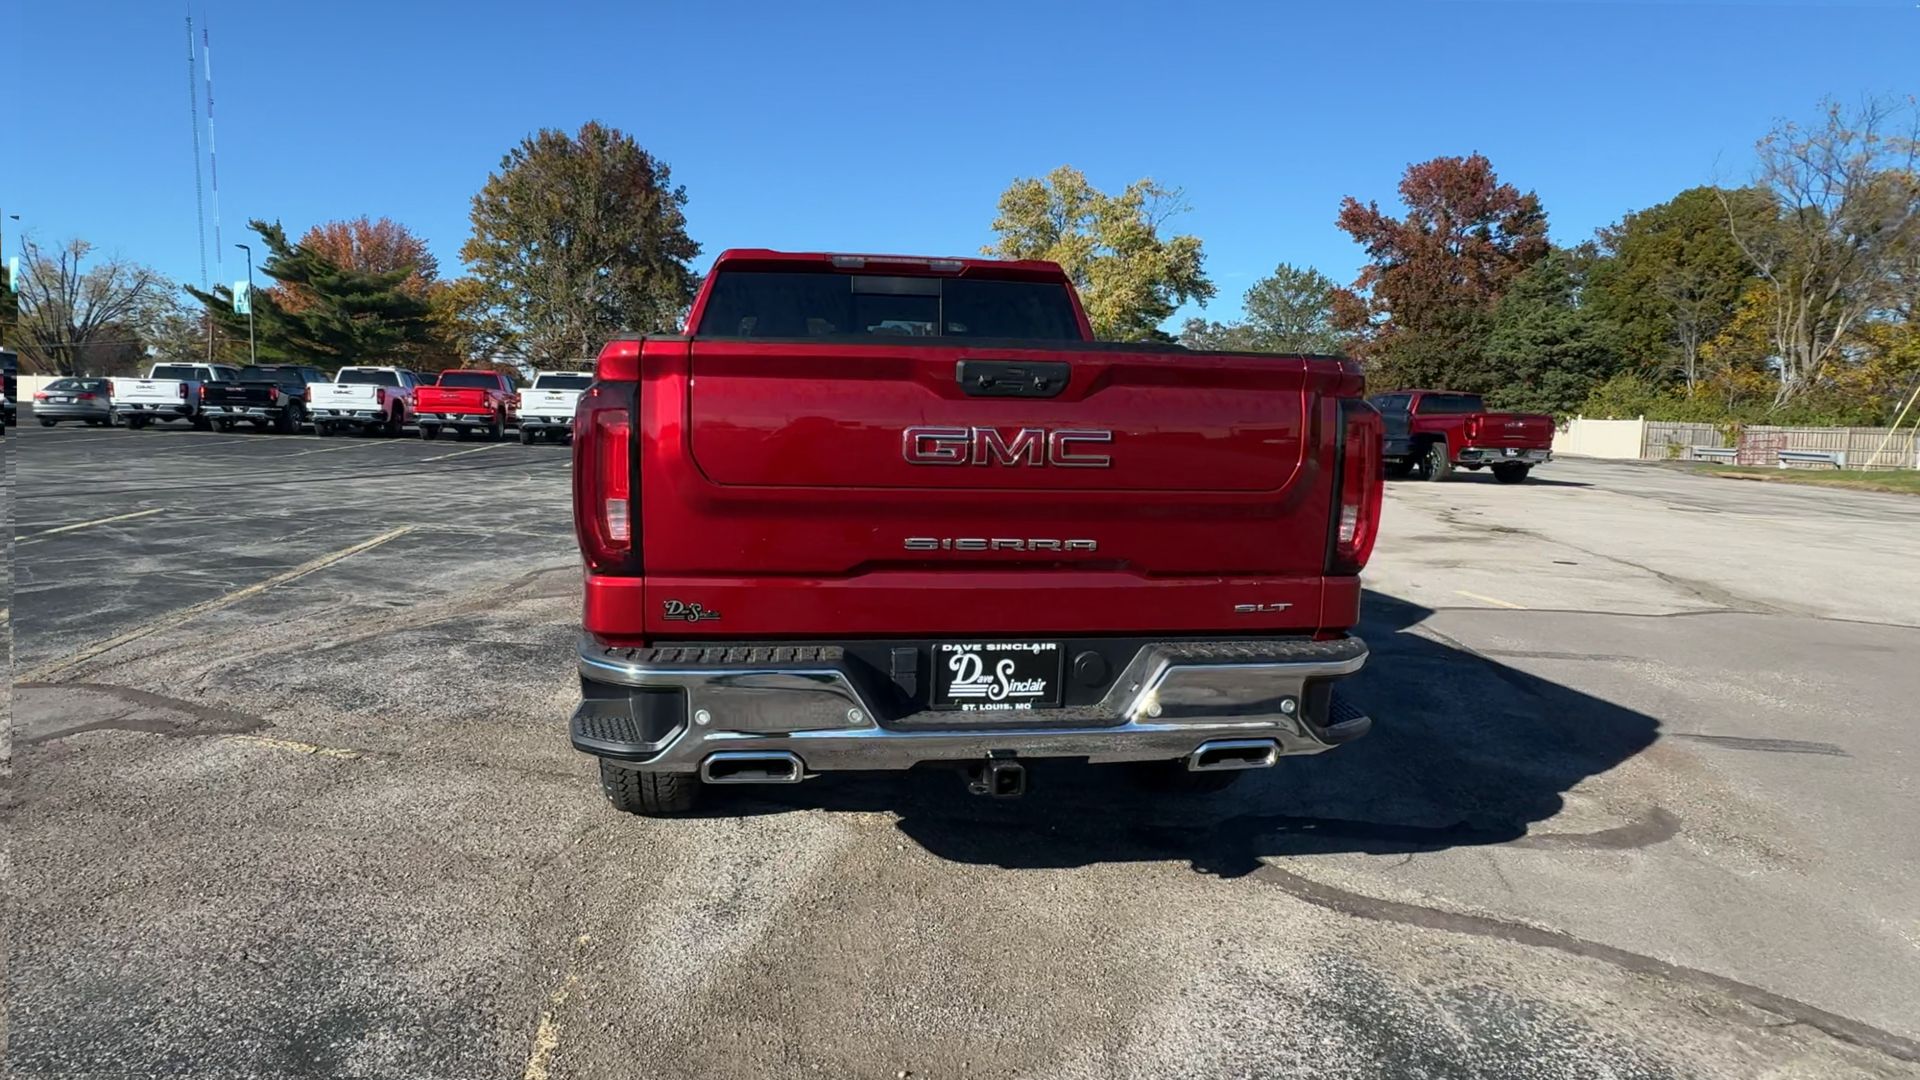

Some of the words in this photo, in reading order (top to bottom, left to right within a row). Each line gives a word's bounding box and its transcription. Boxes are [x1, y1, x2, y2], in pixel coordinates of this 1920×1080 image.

[903, 426, 1111, 466] GMC
[903, 537, 1098, 552] SIERRA
[1235, 603, 1293, 613] SLT
[942, 644, 982, 652] DAVE
[987, 643, 1056, 651] SINCLAIR
[949, 653, 995, 685] Dave
[988, 658, 1047, 701] Sinclair
[962, 703, 978, 712] ST.
[1015, 702, 1032, 710] MO
